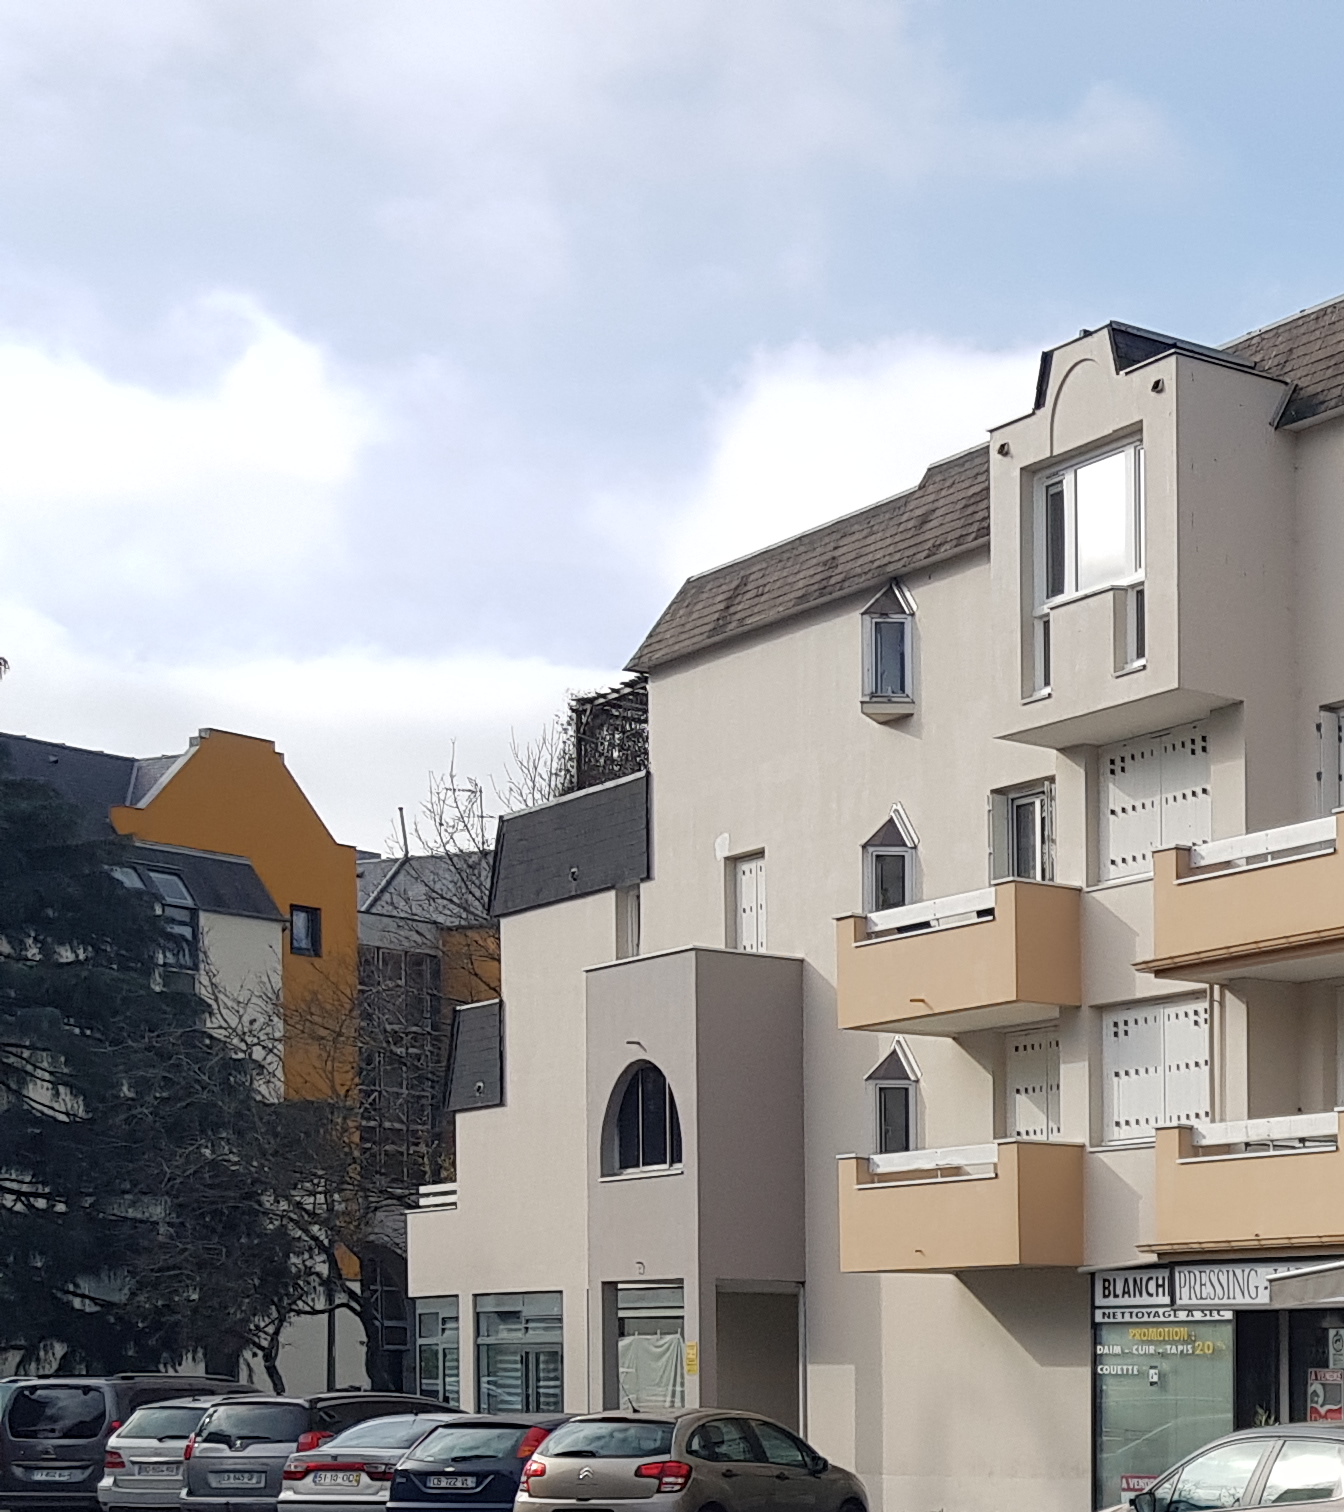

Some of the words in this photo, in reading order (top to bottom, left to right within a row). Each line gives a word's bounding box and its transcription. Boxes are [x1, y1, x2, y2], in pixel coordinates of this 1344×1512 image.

[1178, 1268, 1260, 1301] PRESSING
[1102, 1310, 1180, 1320] NETTOYAGE
[1186, 1310, 1196, 1318] A
[1200, 1310, 1226, 1318] SEC
[1128, 1327, 1188, 1341] PROMOTION
[1096, 1344, 1122, 1355] DAIM
[1132, 1344, 1155, 1355] CUIR
[1166, 1344, 1193, 1355] TAPIS
[1097, 1364, 1139, 1375] COUETTE
[1121, 1478, 1128, 1489] A
